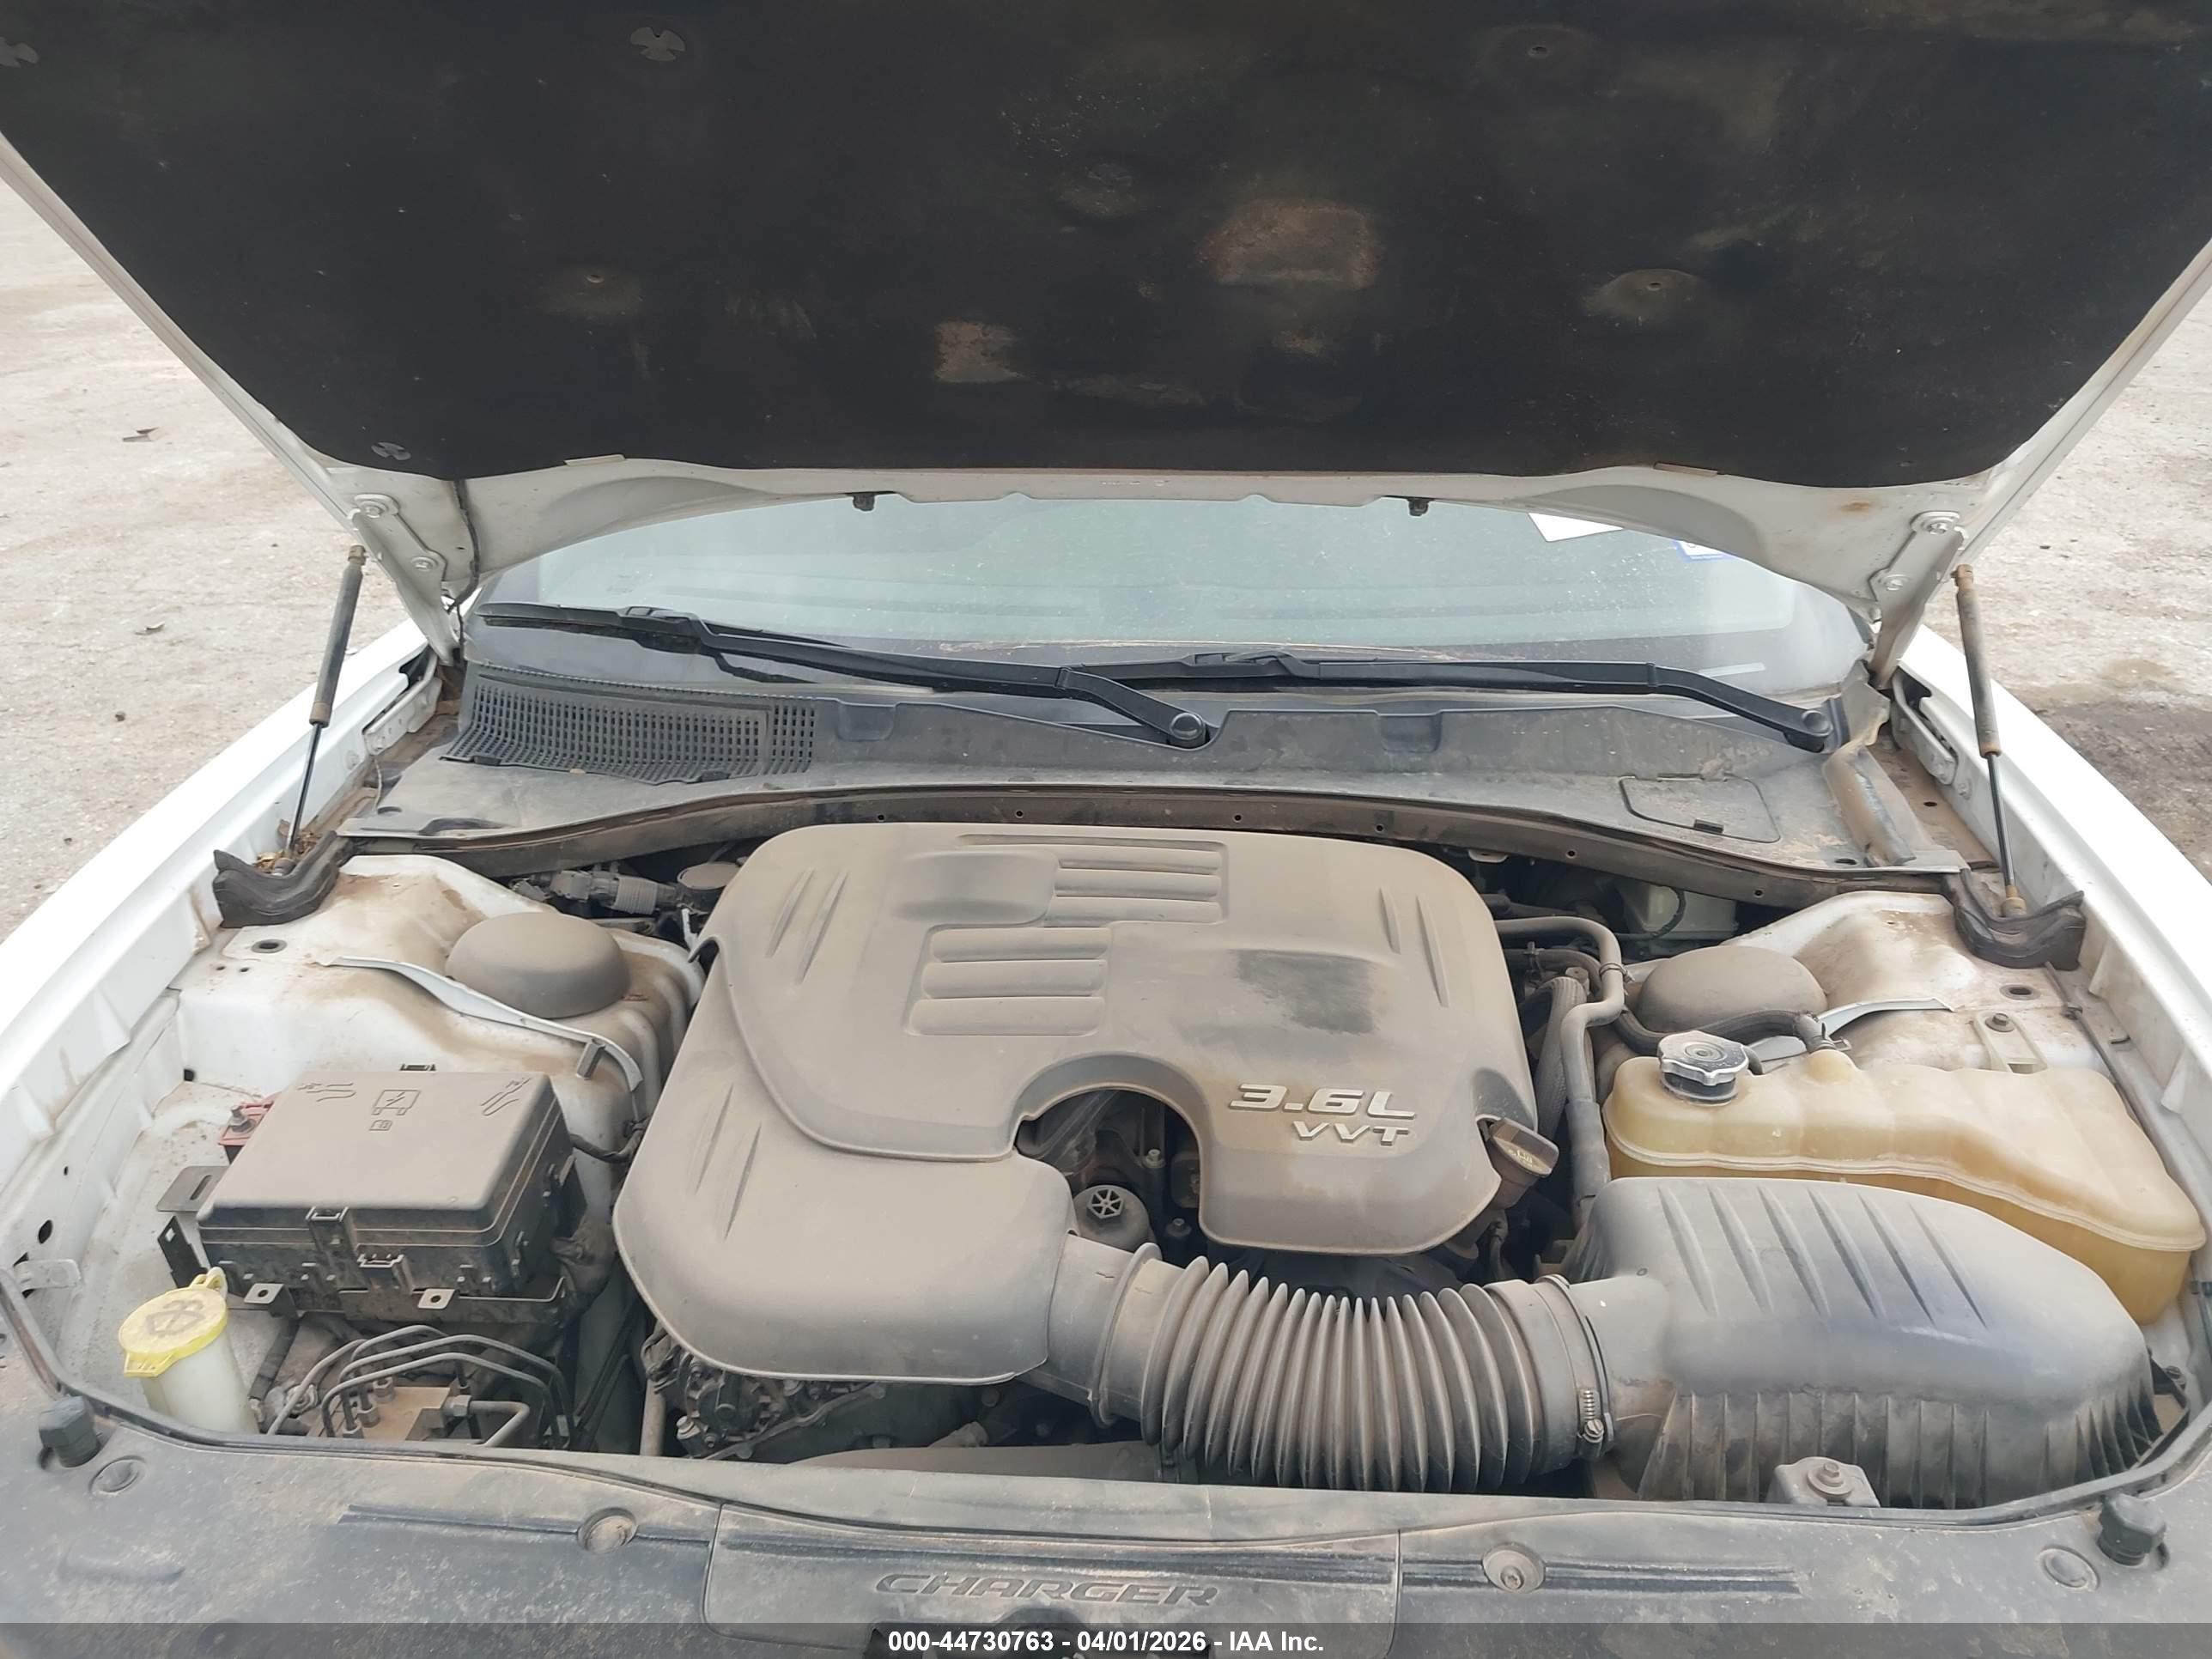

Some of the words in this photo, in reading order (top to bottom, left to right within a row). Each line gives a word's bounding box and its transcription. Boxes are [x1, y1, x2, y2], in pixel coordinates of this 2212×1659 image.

[1229, 1083, 1417, 1121] 3.6L
[1291, 1120, 1410, 1146] VVT
[875, 1573, 1219, 1607] CHARGER
